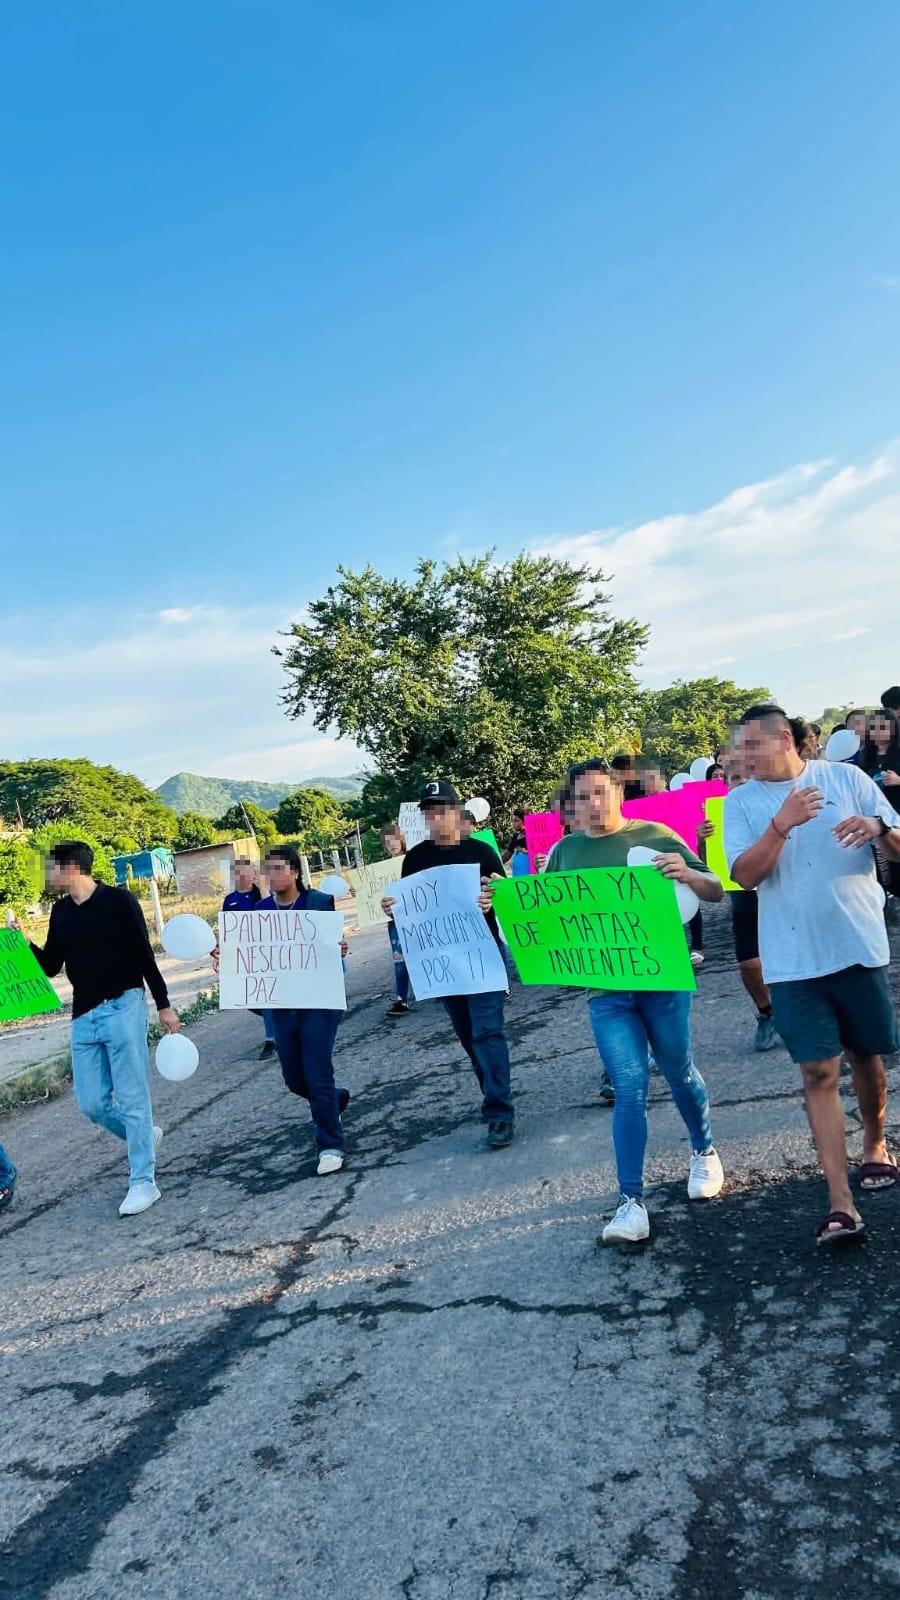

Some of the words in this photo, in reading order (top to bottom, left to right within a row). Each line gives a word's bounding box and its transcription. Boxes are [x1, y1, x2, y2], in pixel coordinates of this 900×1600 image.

[401, 880, 439, 916] HOY
[515, 875, 596, 911] BASTA
[606, 871, 647, 901] YA
[223, 911, 318, 943] PALMILLAS
[512, 920, 544, 949] DE
[559, 911, 649, 944] MATAR
[236, 943, 318, 975] NESECITA
[421, 954, 456, 987] POR
[463, 947, 485, 980] TI
[548, 946, 662, 977] INOCENTES
[244, 975, 279, 1005] PAZ
